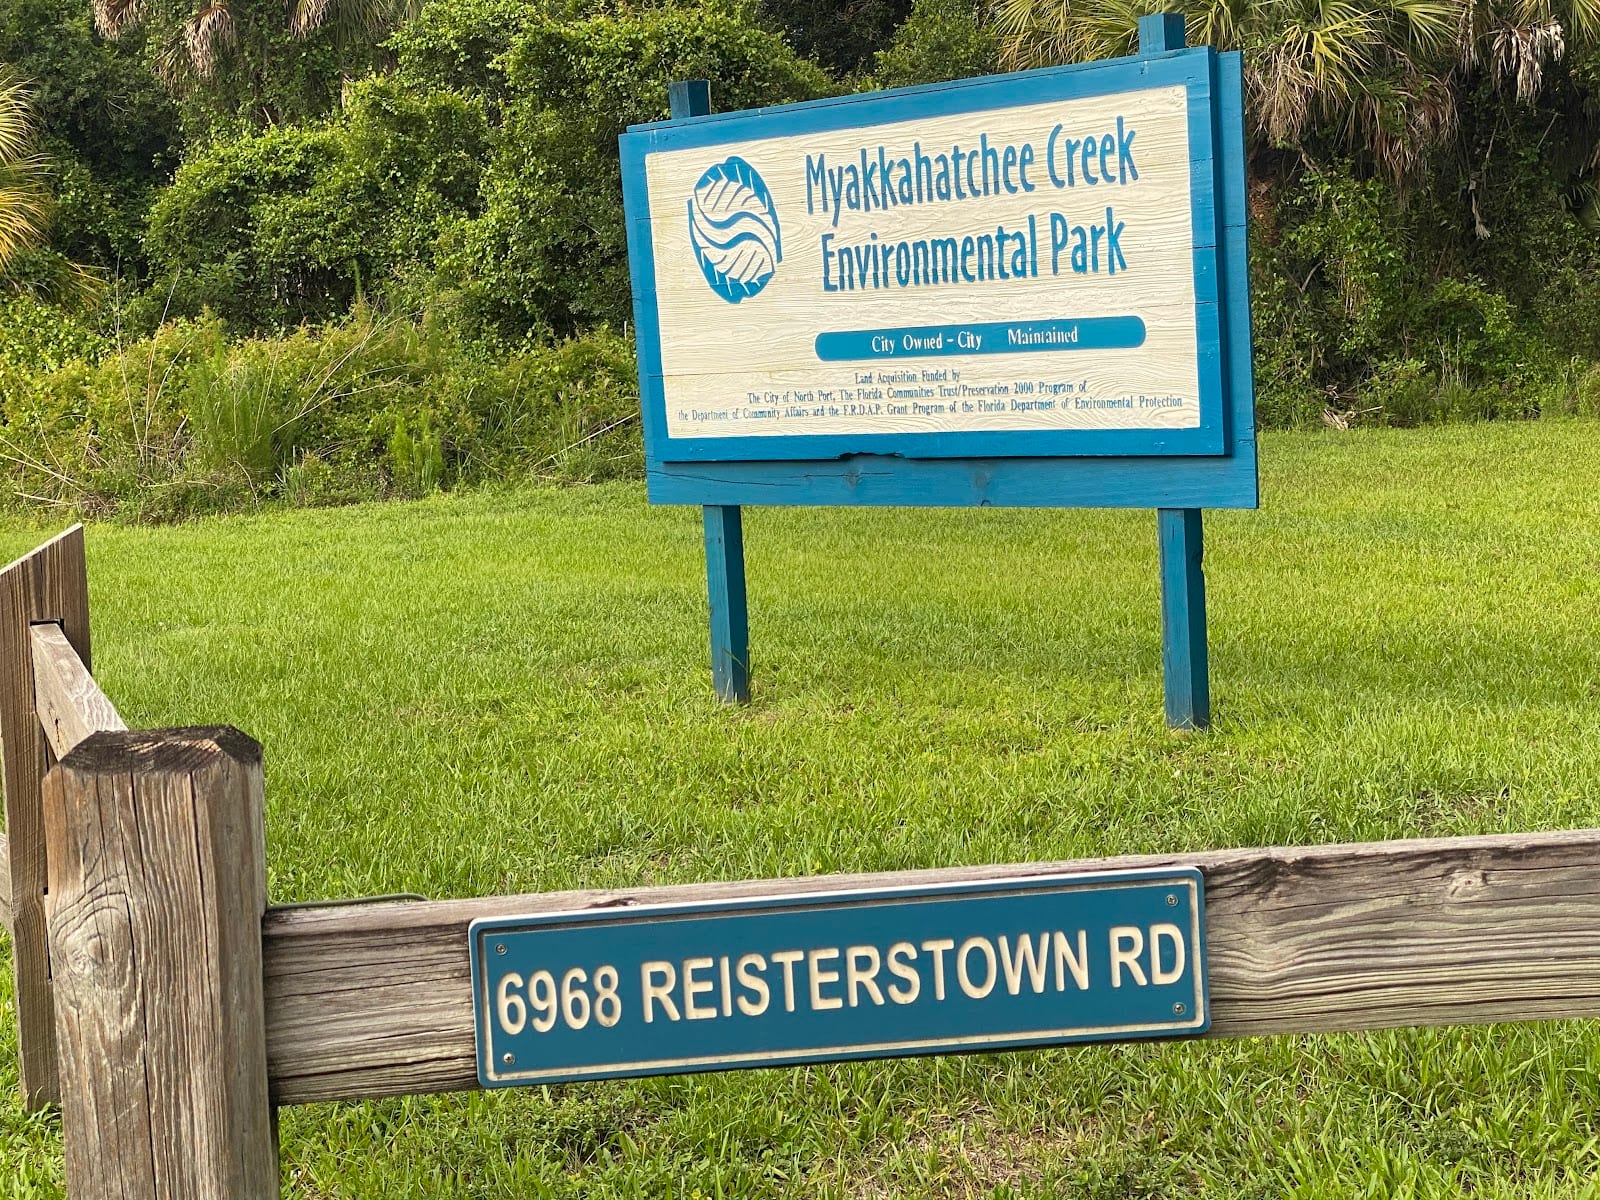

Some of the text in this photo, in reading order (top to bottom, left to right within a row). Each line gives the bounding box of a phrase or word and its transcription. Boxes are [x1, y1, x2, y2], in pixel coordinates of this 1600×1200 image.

[806, 116, 1138, 227] Myakkahatchee Creek
[821, 207, 1127, 291] Environmental Park
[871, 335, 896, 354] City
[903, 331, 942, 351] Owned
[957, 330, 982, 351] City
[1008, 326, 1078, 345] Maintained
[855, 369, 960, 384] Land Acquisition Funded by
[747, 392, 760, 404] The
[764, 392, 779, 405] City
[782, 391, 790, 403] of
[794, 391, 814, 402] North
[839, 389, 853, 401] The
[857, 388, 882, 400] Florida
[887, 386, 934, 400] Communities
[938, 382, 1009, 397] Trust/Preservation
[1014, 381, 1034, 394] 2000
[1039, 381, 1074, 395] Program
[1079, 380, 1087, 392] of
[678, 410, 688, 421] the
[692, 409, 729, 421] Department
[732, 409, 739, 420] of
[743, 407, 780, 420] Community
[784, 406, 809, 418] Affairs
[812, 405, 824, 417] and
[828, 405, 839, 416] the
[887, 404, 908, 415] Grant
[913, 402, 945, 415] Program
[949, 401, 957, 413] of
[962, 401, 974, 413] the
[978, 400, 1006, 412] Florida
[1011, 398, 1056, 413] Department
[1061, 397, 1069, 410] of
[1075, 395, 1133, 409] Environmental
[1139, 394, 1183, 408] Protection
[498, 923, 1185, 1036] 6968 REISTERSTOWN RD
